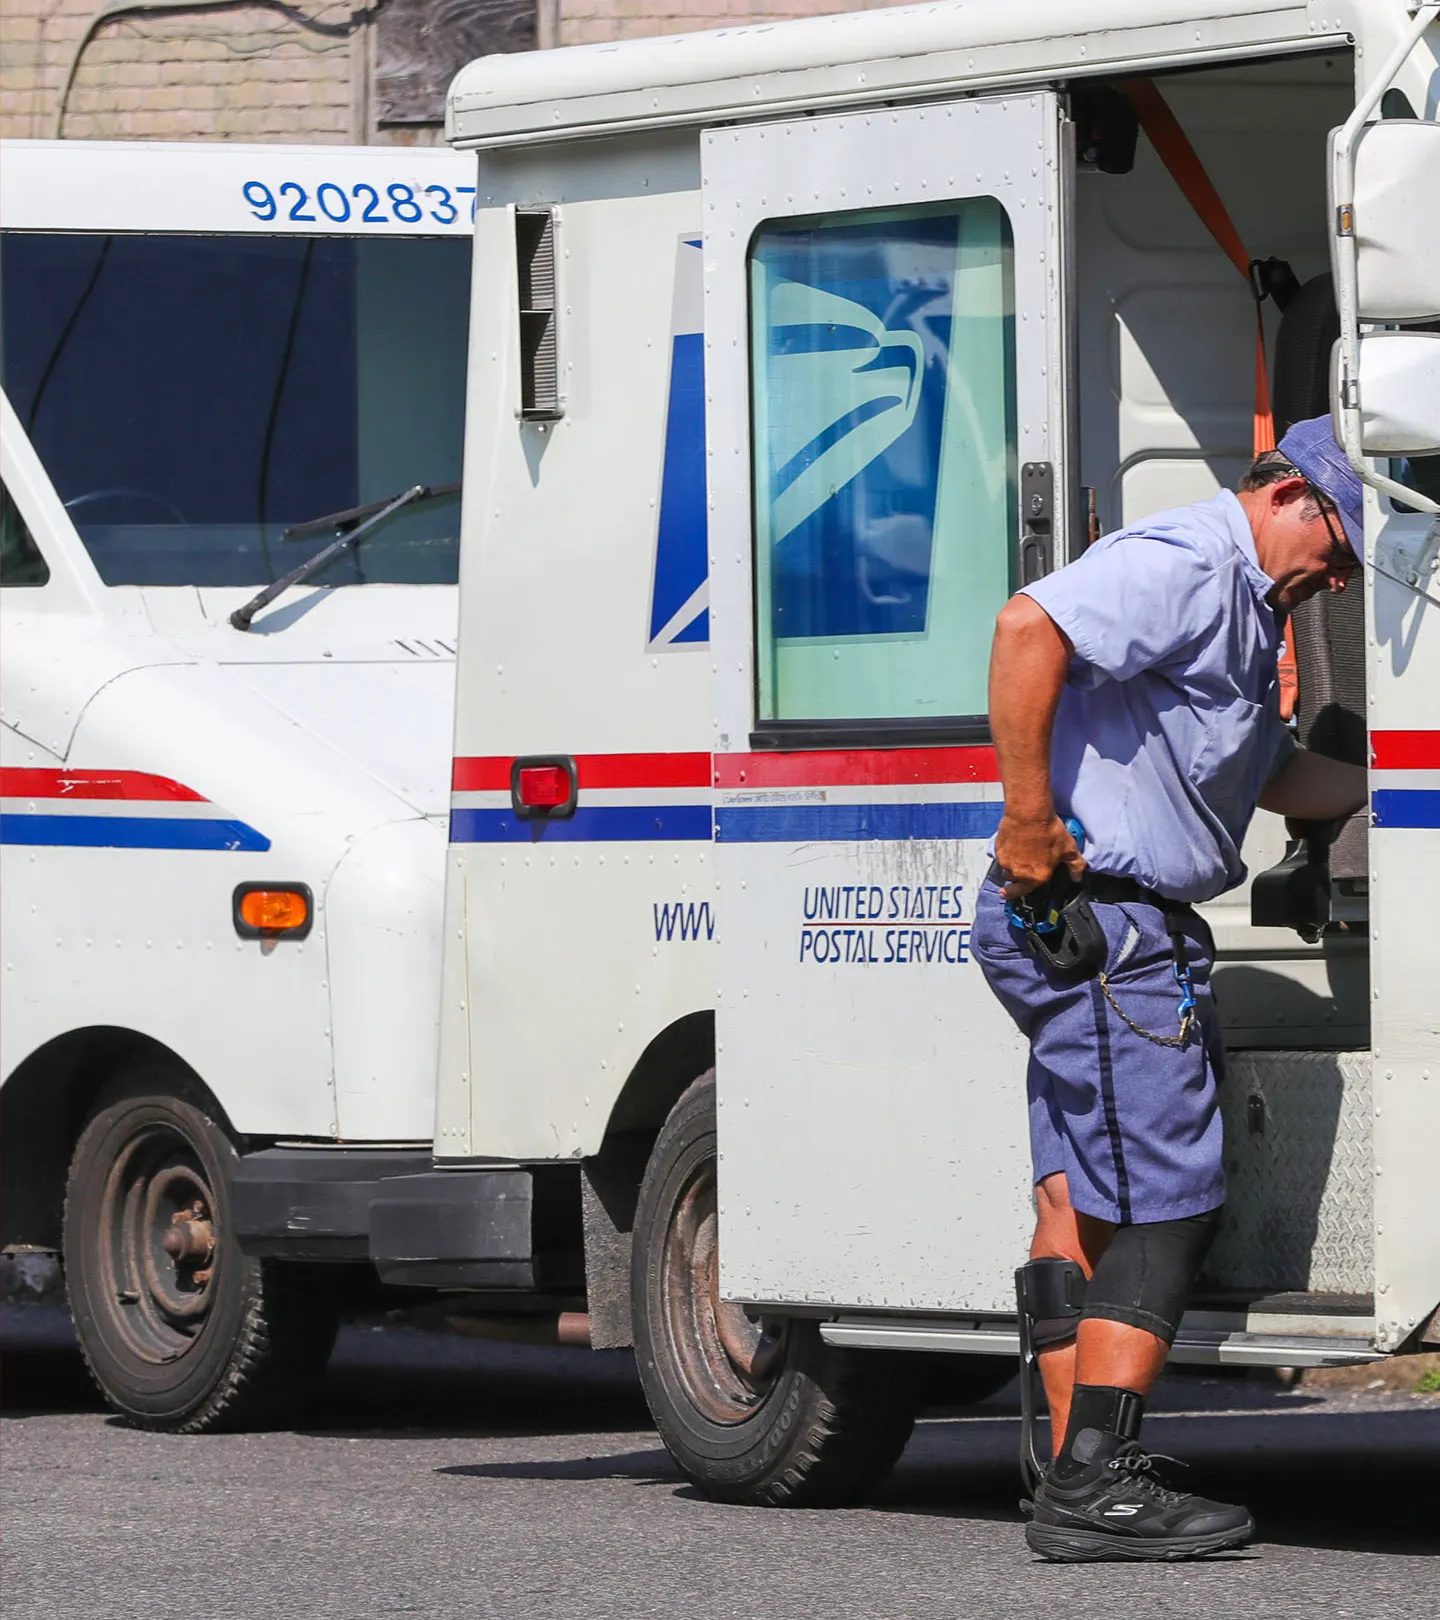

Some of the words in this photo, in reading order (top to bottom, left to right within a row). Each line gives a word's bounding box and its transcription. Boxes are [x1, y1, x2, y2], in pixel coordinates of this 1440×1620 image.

[803, 886, 884, 920] UNITED
[888, 886, 963, 919] STATES
[800, 929, 879, 964] POSTAL
[883, 929, 971, 964] SERVICE
